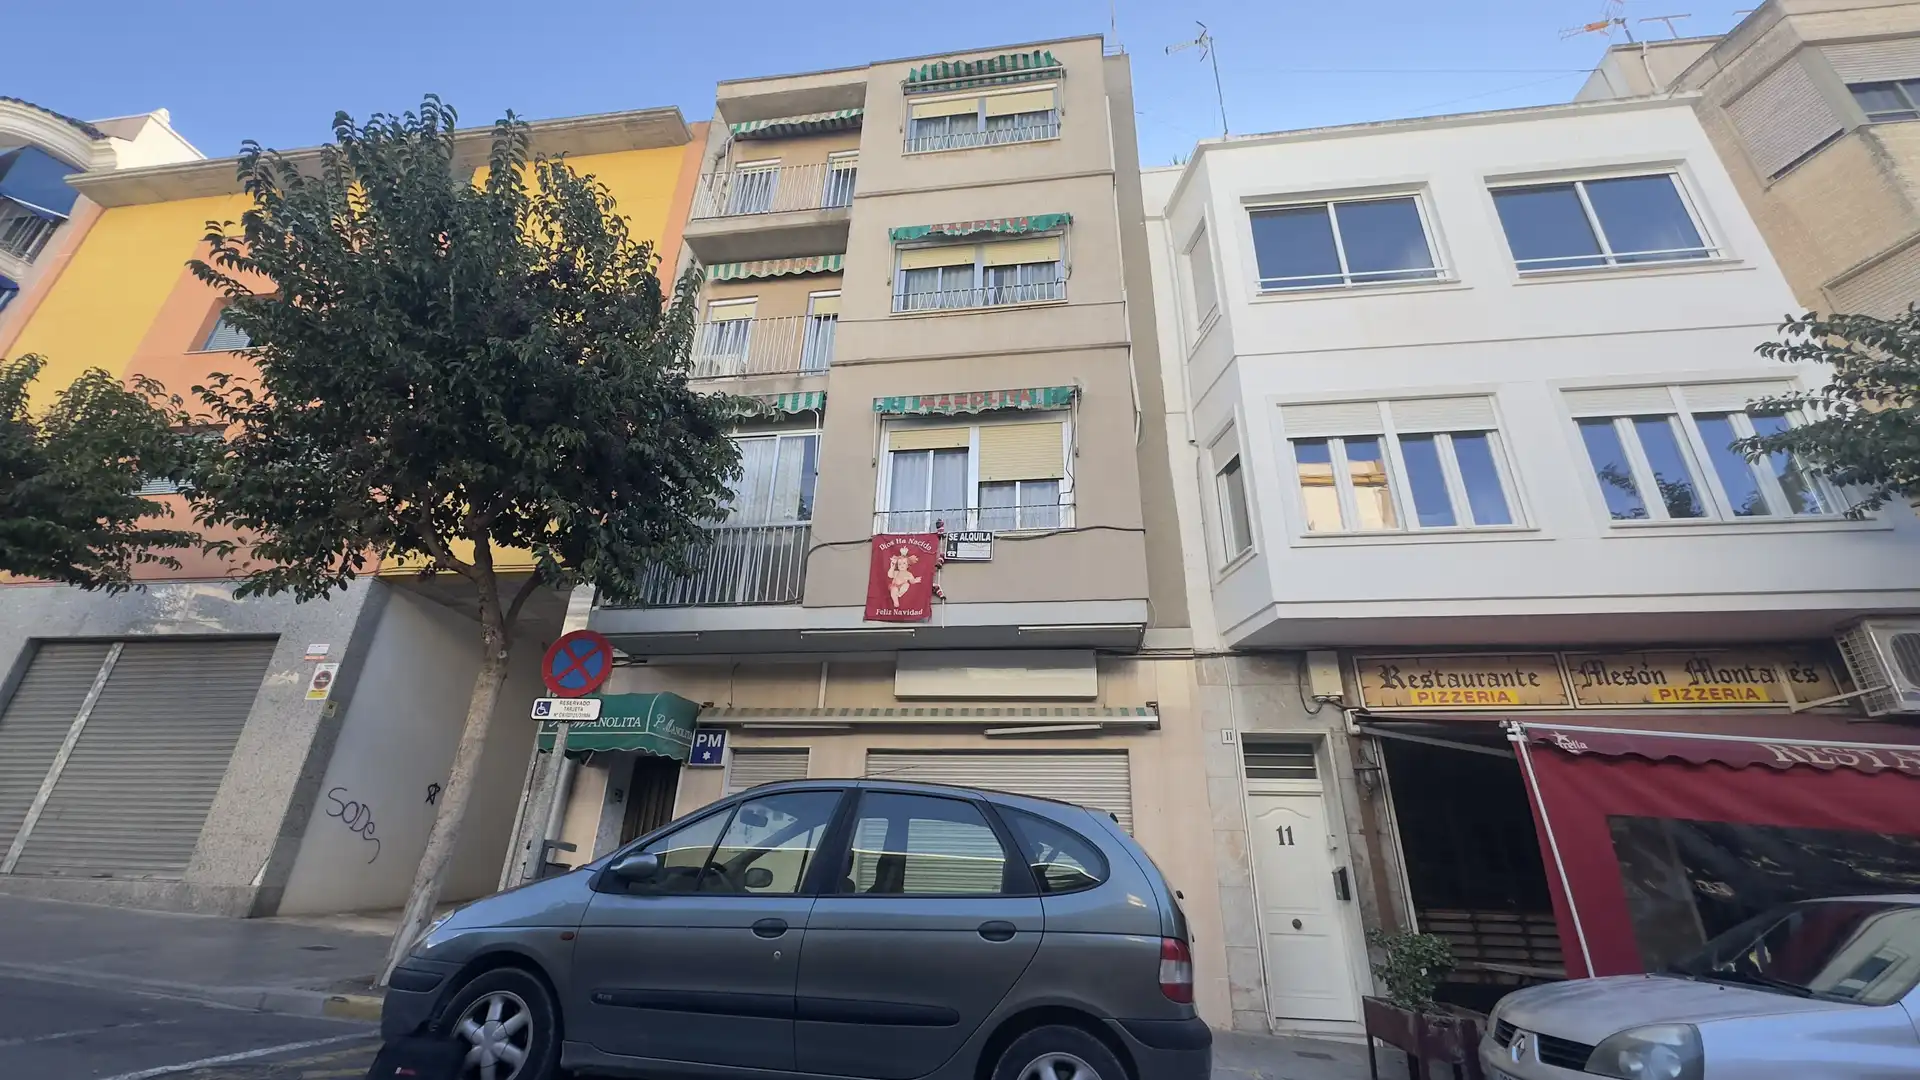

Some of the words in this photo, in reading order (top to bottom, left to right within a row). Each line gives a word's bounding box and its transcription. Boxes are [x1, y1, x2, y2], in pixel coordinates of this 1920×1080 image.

[948, 533, 958, 541] SE
[960, 532, 991, 541] ALQUILA
[1377, 664, 1541, 690] Restaurante
[1578, 659, 1667, 688] Mesón
[1416, 691, 1512, 704] PIZZERIA
[1658, 687, 1761, 701] PIZZERIA
[696, 734, 722, 747] PM
[1276, 825, 1295, 846] 11
